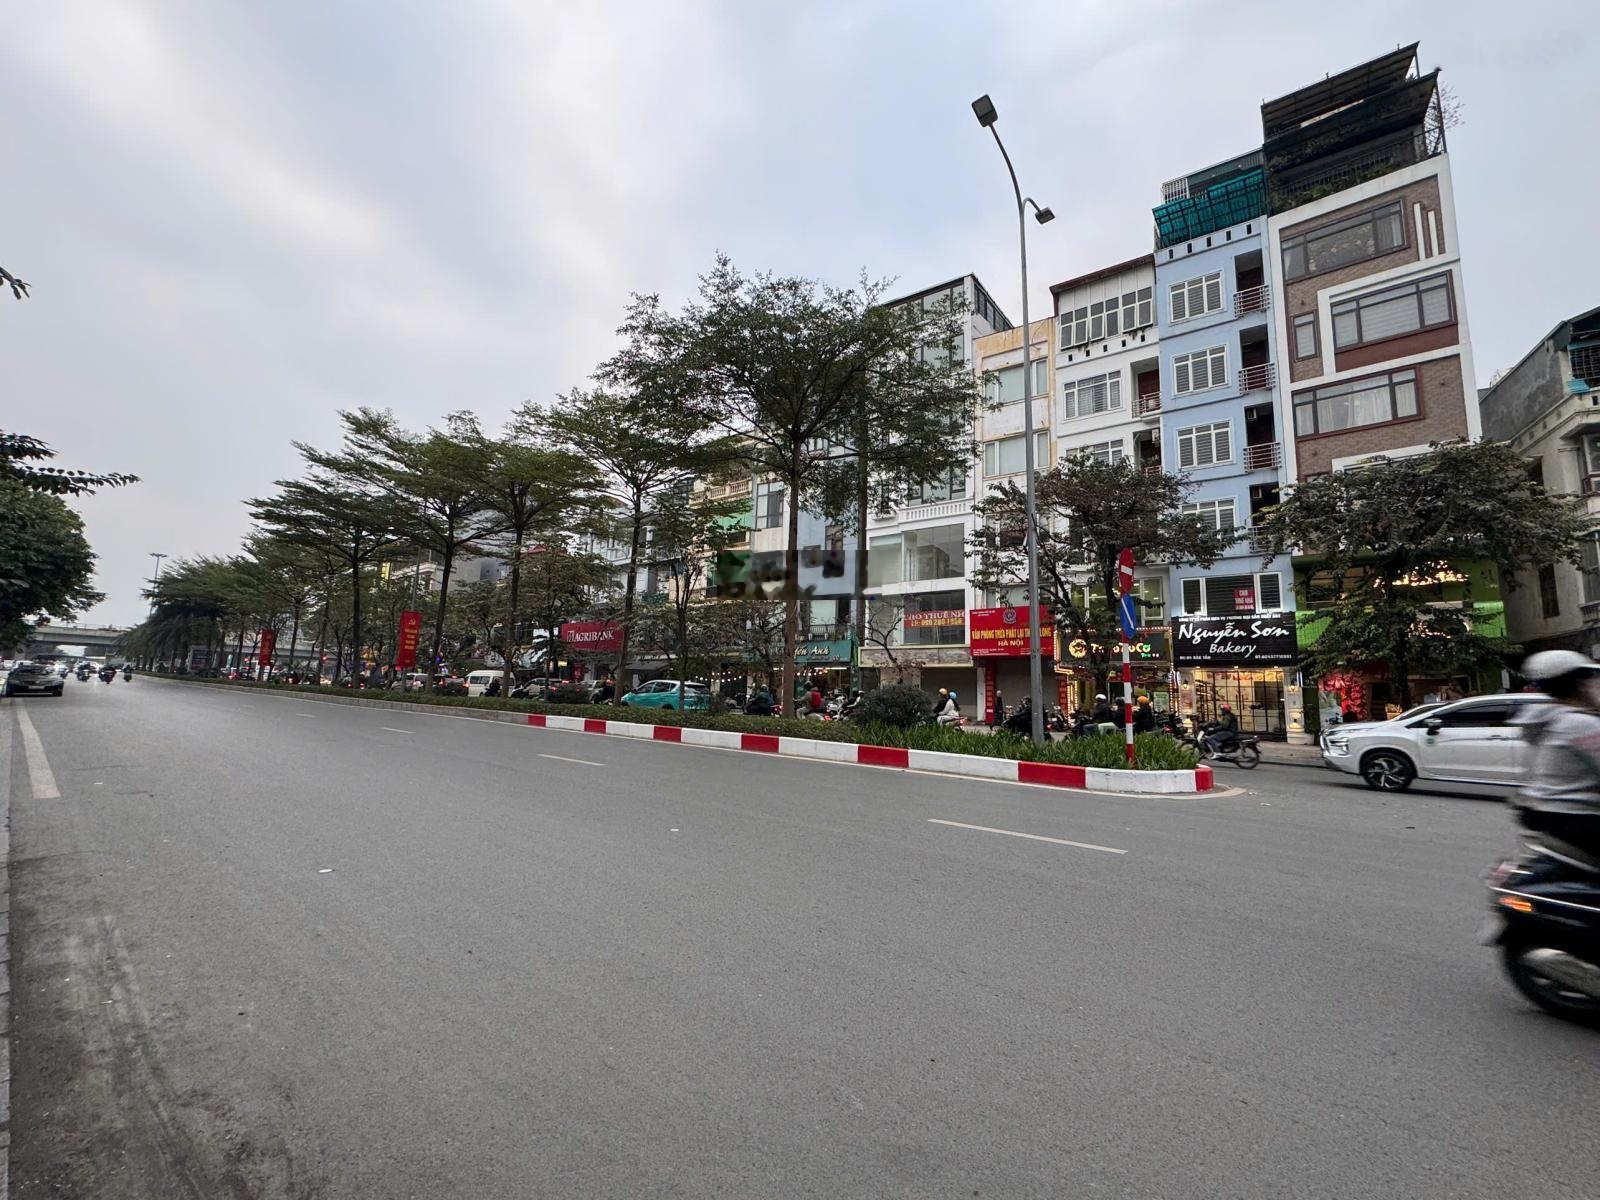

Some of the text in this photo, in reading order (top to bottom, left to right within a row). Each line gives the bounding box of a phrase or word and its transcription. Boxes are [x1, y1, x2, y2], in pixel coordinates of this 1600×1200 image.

[950, 609, 965, 618] NH
[574, 630, 615, 642] AGRIBANK
[1178, 621, 1290, 644] Nguyễn Sơn
[1010, 639, 1024, 647] NỘI
[1090, 642, 1151, 654] TooCo
[1209, 641, 1257, 658] Bakery
